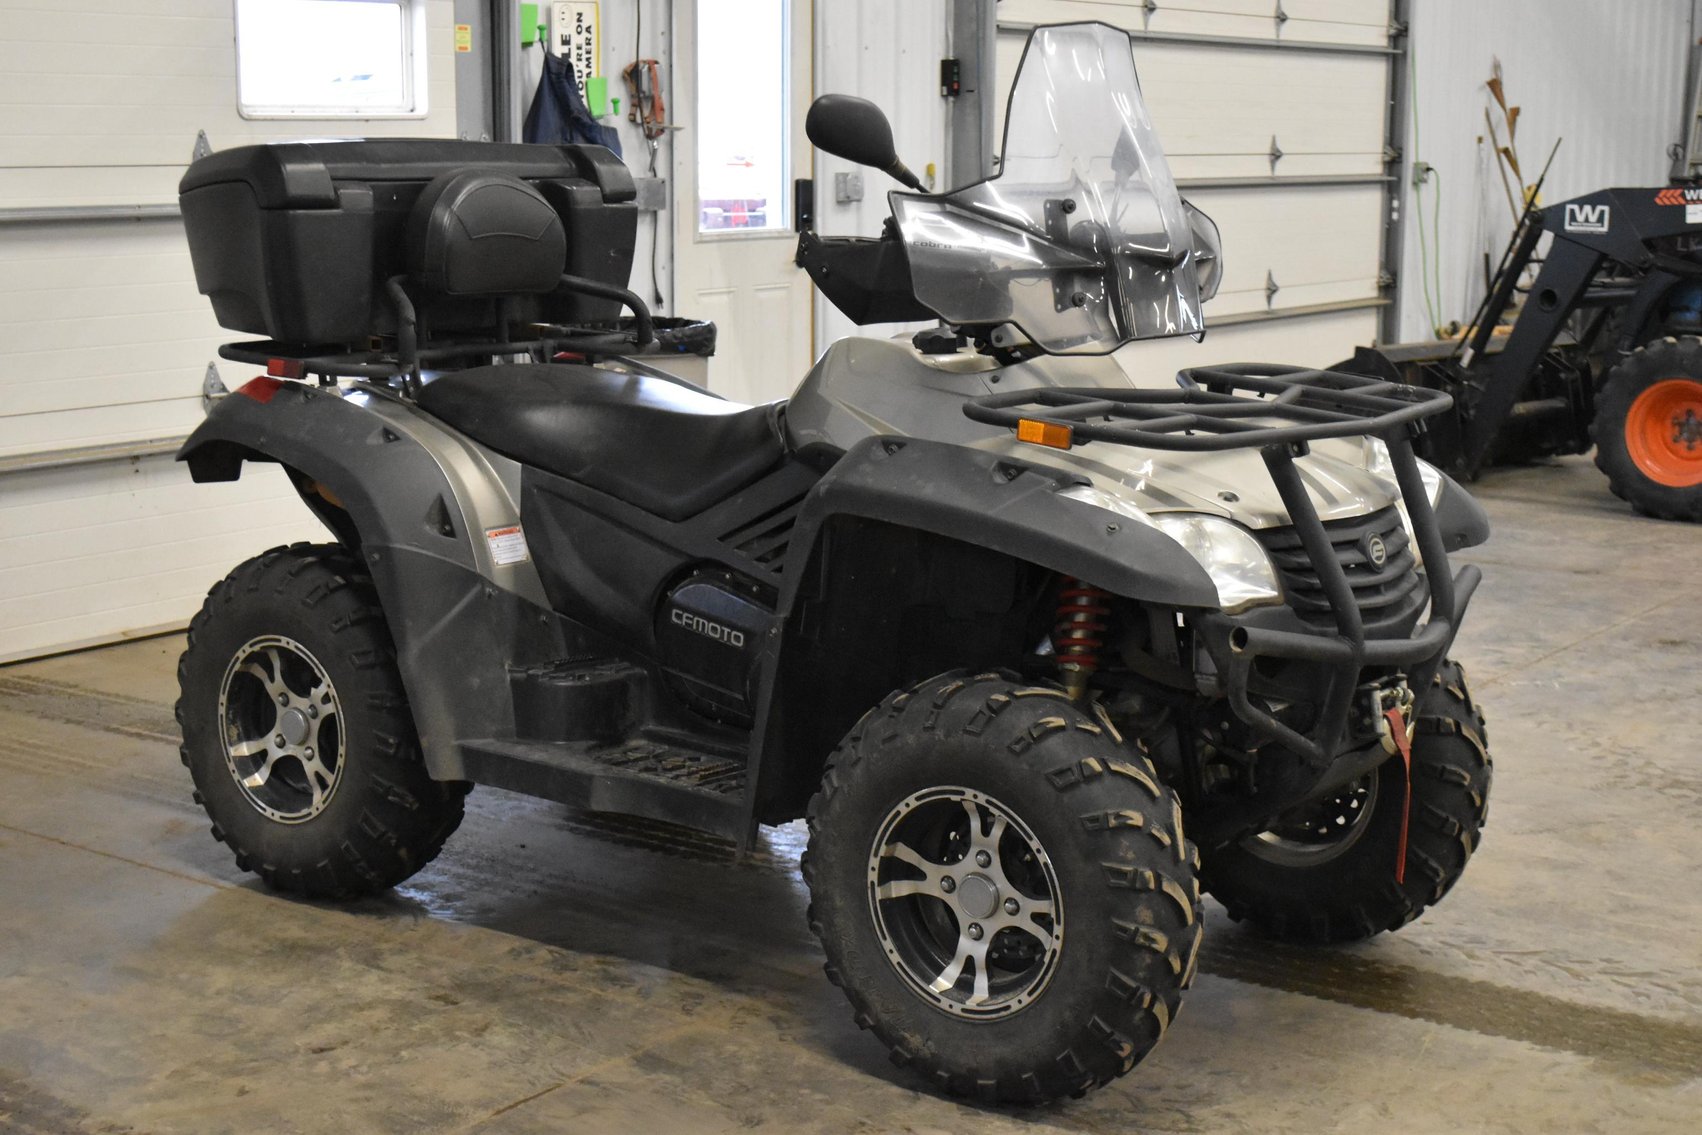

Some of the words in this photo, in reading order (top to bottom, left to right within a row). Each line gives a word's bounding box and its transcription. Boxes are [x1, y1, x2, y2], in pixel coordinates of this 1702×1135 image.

[576, 12, 583, 35] ON
[561, 34, 571, 59] LE
[913, 240, 952, 249] cobra
[671, 608, 744, 647] CFMOTO
